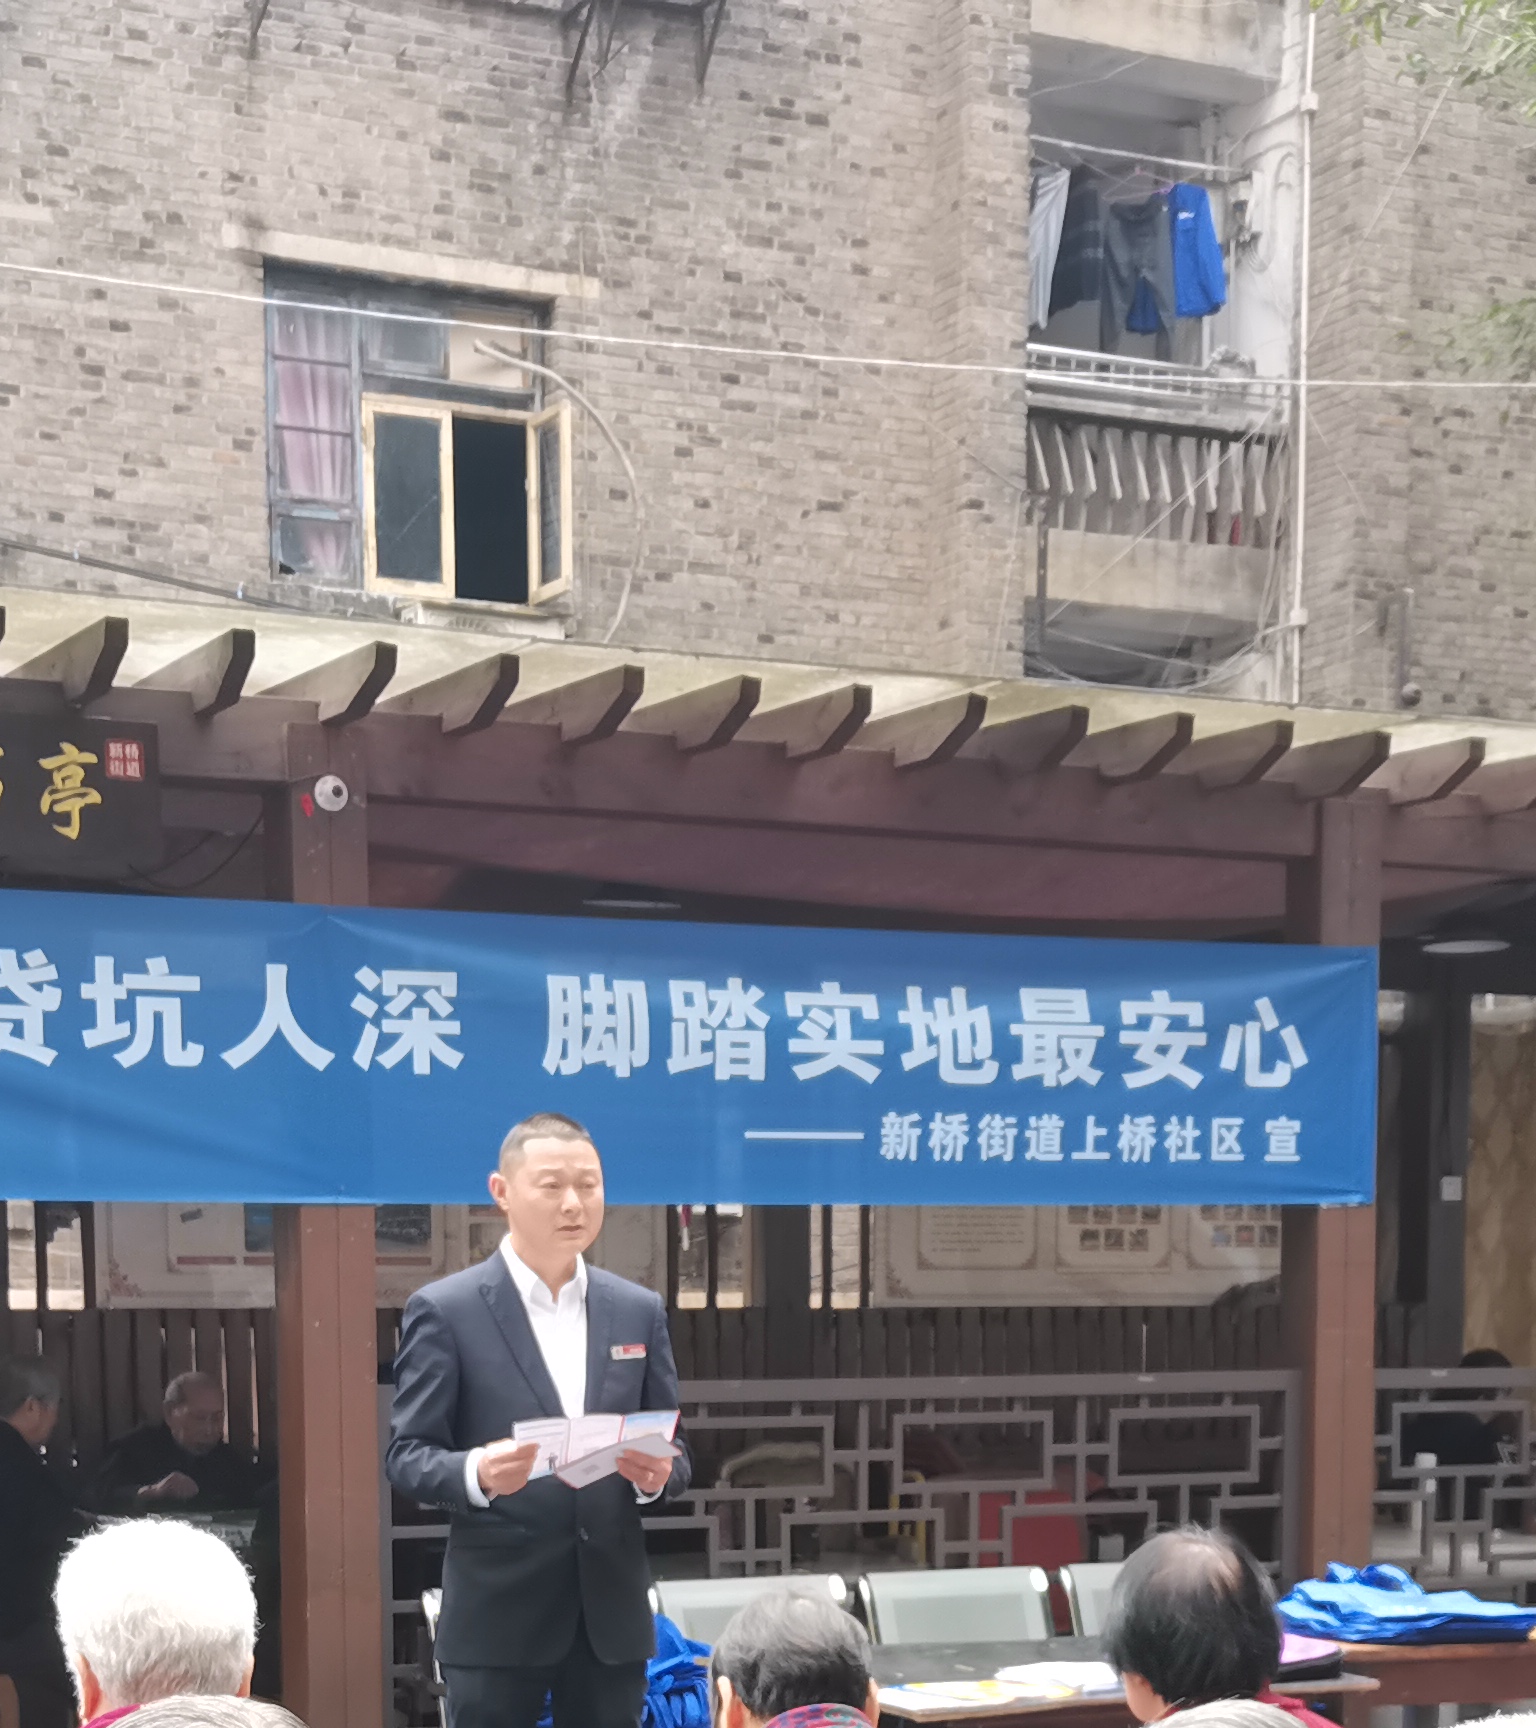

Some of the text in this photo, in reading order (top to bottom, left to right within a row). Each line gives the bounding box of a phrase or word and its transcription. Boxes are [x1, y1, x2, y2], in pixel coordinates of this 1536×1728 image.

[542, 972, 1309, 1090] 脚踏实地最安心
